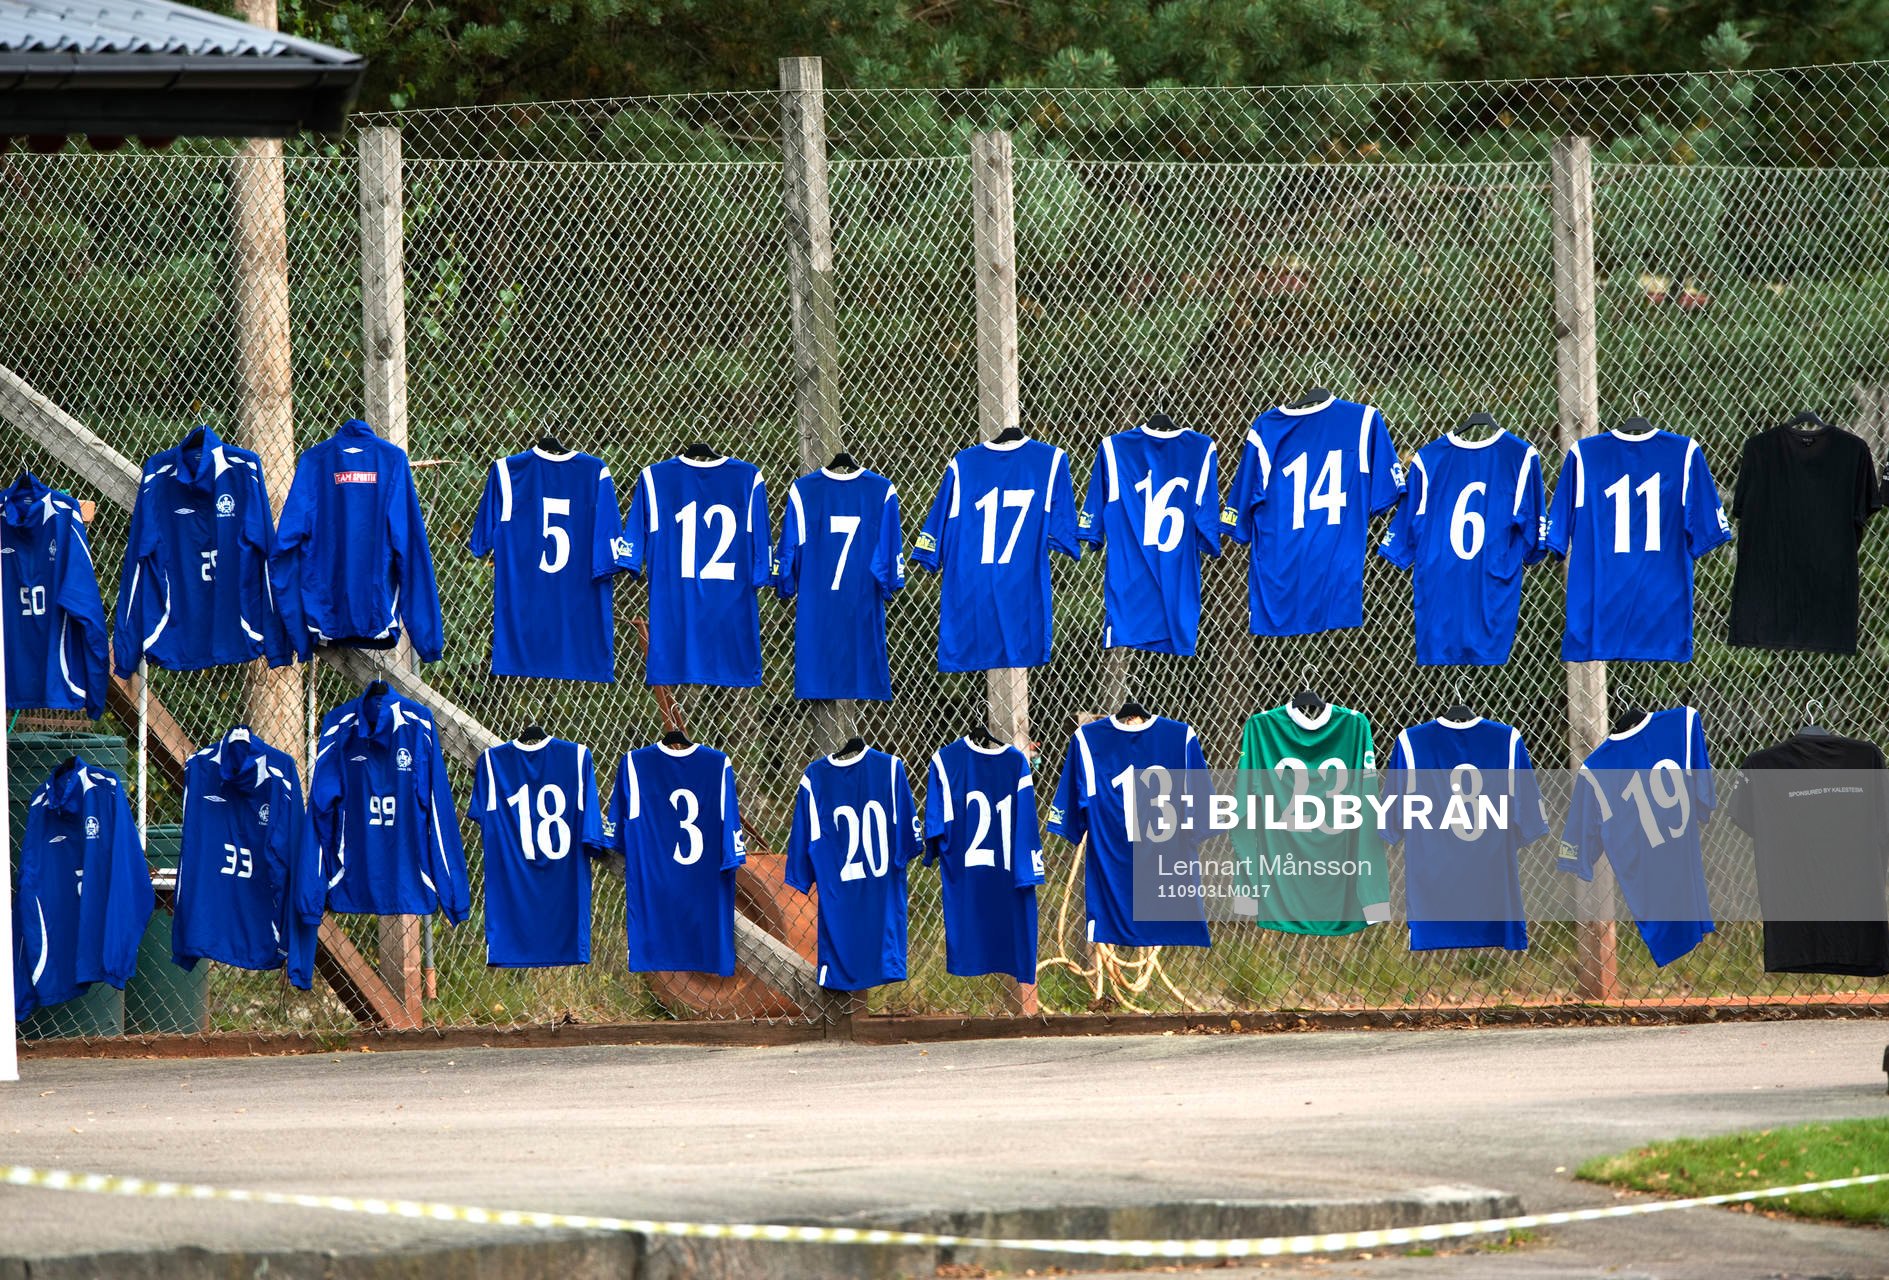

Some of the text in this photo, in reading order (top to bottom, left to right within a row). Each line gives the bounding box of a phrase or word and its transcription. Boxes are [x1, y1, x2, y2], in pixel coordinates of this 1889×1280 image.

[975, 487, 1034, 563] 17
[1135, 470, 1189, 552] 16
[1283, 450, 1346, 529] 14
[1450, 482, 1486, 560] 6
[1604, 472, 1661, 553] 11
[539, 497, 570, 573] 5
[675, 501, 737, 580] 12
[830, 516, 861, 590] 7
[20, 586, 46, 615] 50
[369, 796, 396, 826] 99
[506, 784, 571, 860] 18
[669, 789, 704, 865] 3
[965, 790, 1012, 870] 21
[1111, 764, 1177, 843] 13
[1274, 757, 1348, 835] 23
[1450, 763, 1484, 842] 8
[1621, 758, 1690, 848] 19
[220, 843, 253, 878] 33
[833, 800, 889, 882] 20
